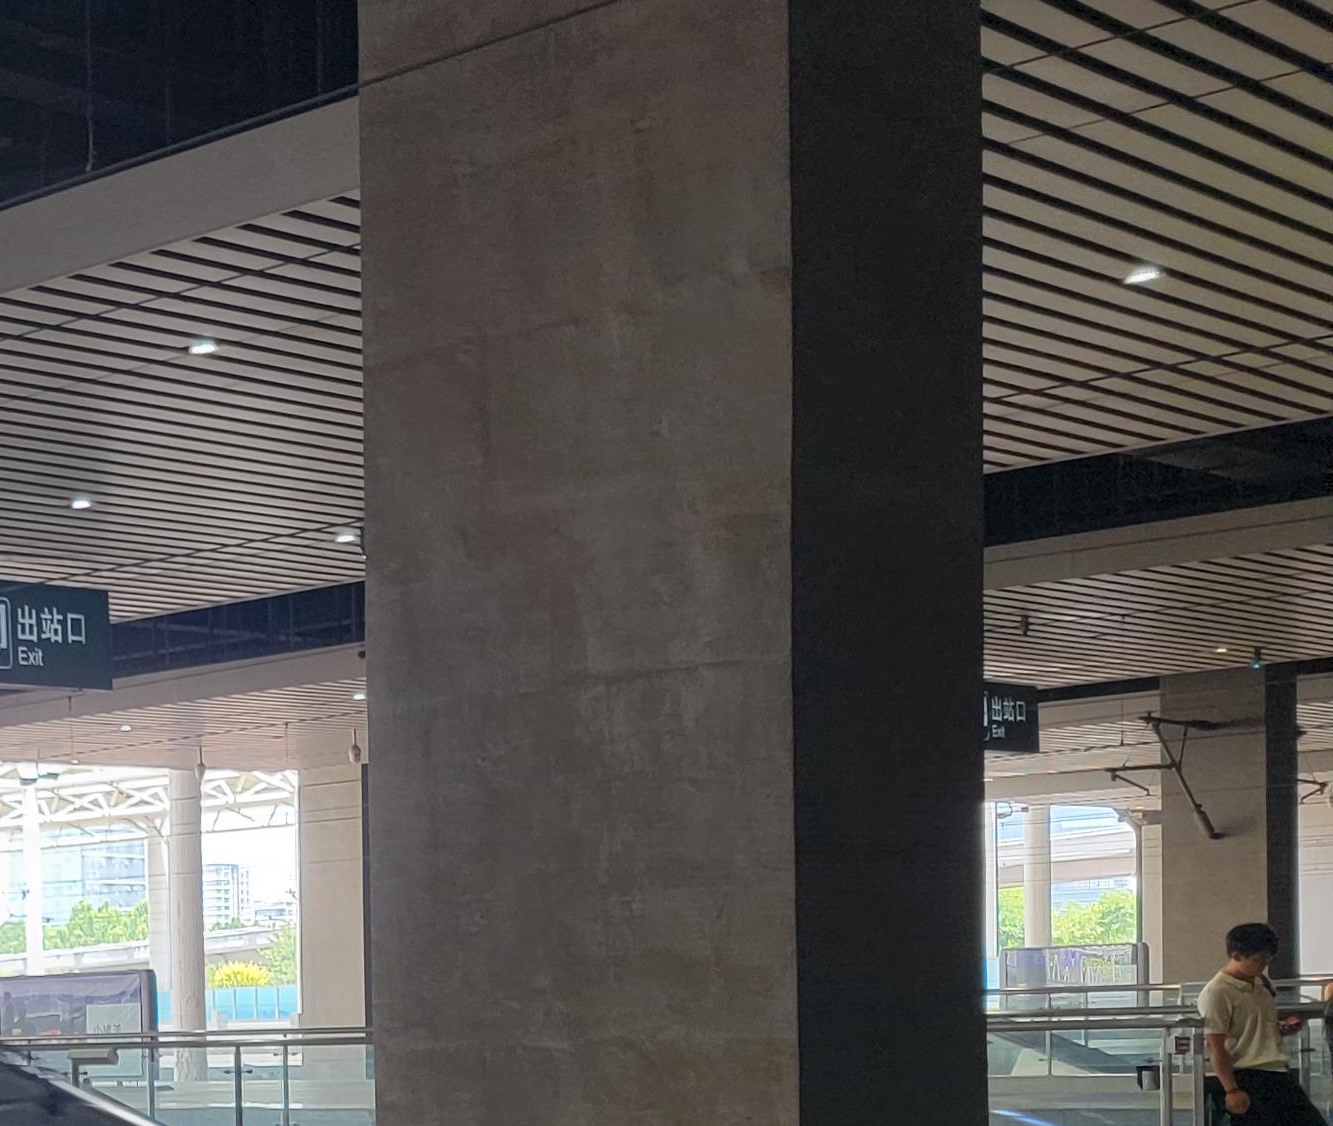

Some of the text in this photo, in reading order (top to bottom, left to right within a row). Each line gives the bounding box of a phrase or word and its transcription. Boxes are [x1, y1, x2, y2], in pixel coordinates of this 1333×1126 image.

[17, 605, 86, 645] 出站口
[17, 646, 44, 667] Exit
[991, 696, 1027, 722] 出站口
[991, 724, 1006, 738] Exit
